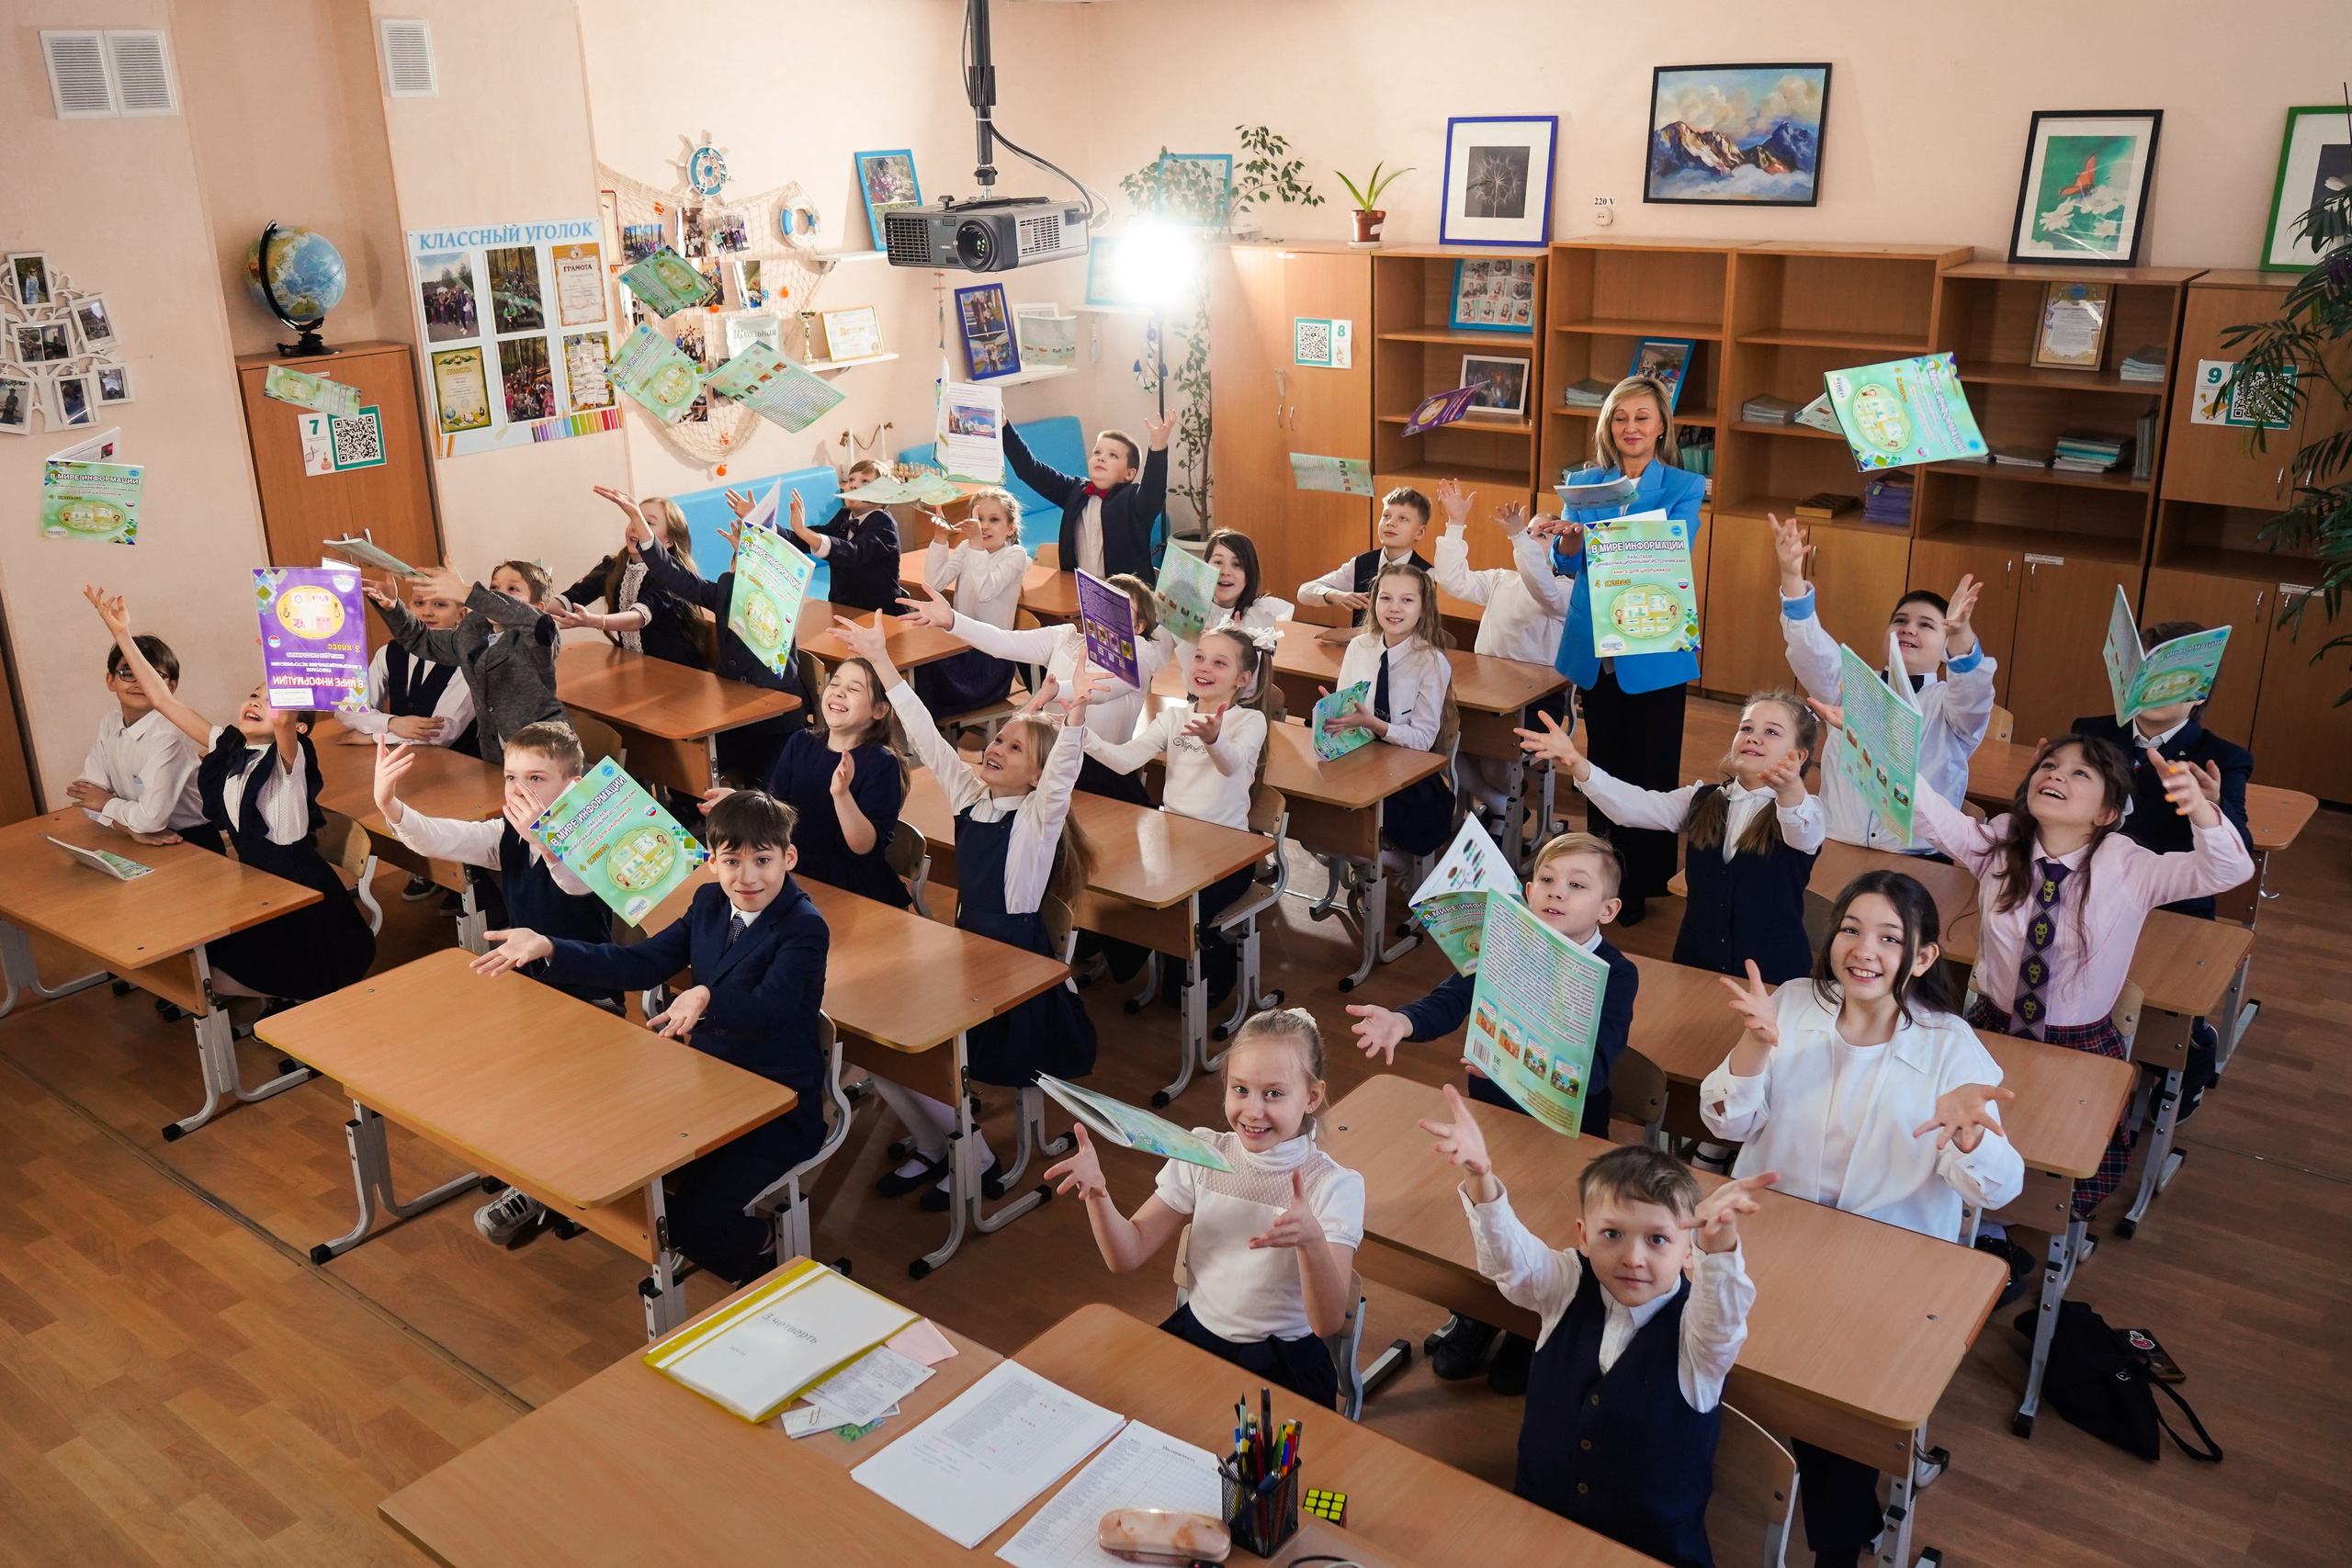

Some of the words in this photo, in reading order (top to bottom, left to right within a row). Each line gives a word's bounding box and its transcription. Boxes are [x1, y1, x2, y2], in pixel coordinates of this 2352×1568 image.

[420, 224, 520, 250] КЛАССНЫЙ
[522, 222, 594, 244] УГОЛОК
[563, 264, 593, 273] ГРАМОТА
[734, 329, 776, 340] Школьная
[1337, 324, 1345, 337] 8
[628, 331, 658, 367] ИНФОРМАЦИИ
[1926, 360, 1935, 368] В
[2207, 367, 2222, 384] 9
[309, 419, 319, 435] 7
[81, 475, 139, 485] ИНФОРМАЦИИ
[744, 540, 751, 549] В
[751, 544, 769, 560] МИРЕ
[1590, 543, 1598, 552] В
[1599, 542, 1623, 552] МИРЕ
[1624, 539, 1685, 552] ИНФОРМАЦИИ
[1594, 580, 1600, 588] 4
[1604, 578, 1632, 587] класс
[326, 643, 352, 651] класс
[354, 644, 360, 652] 3
[271, 673, 334, 687] ИНФОРМАЦИИ
[334, 677, 356, 688] МИРЕ
[356, 678, 363, 688] В
[607, 787, 638, 816] ИСТОЧНИКАМИ
[548, 836, 560, 848] В
[555, 818, 580, 841] МИРЕ
[574, 773, 628, 824] ИНФОРМАЦИИ
[586, 807, 608, 829] РАБОТАЕМ
[577, 863, 587, 873] 4
[584, 841, 611, 866] класс
[1431, 905, 1458, 918] МИРЕ
[1459, 902, 1487, 910] ИНФО
[762, 1312, 774, 1320] 3
[773, 1316, 817, 1344] четверть
